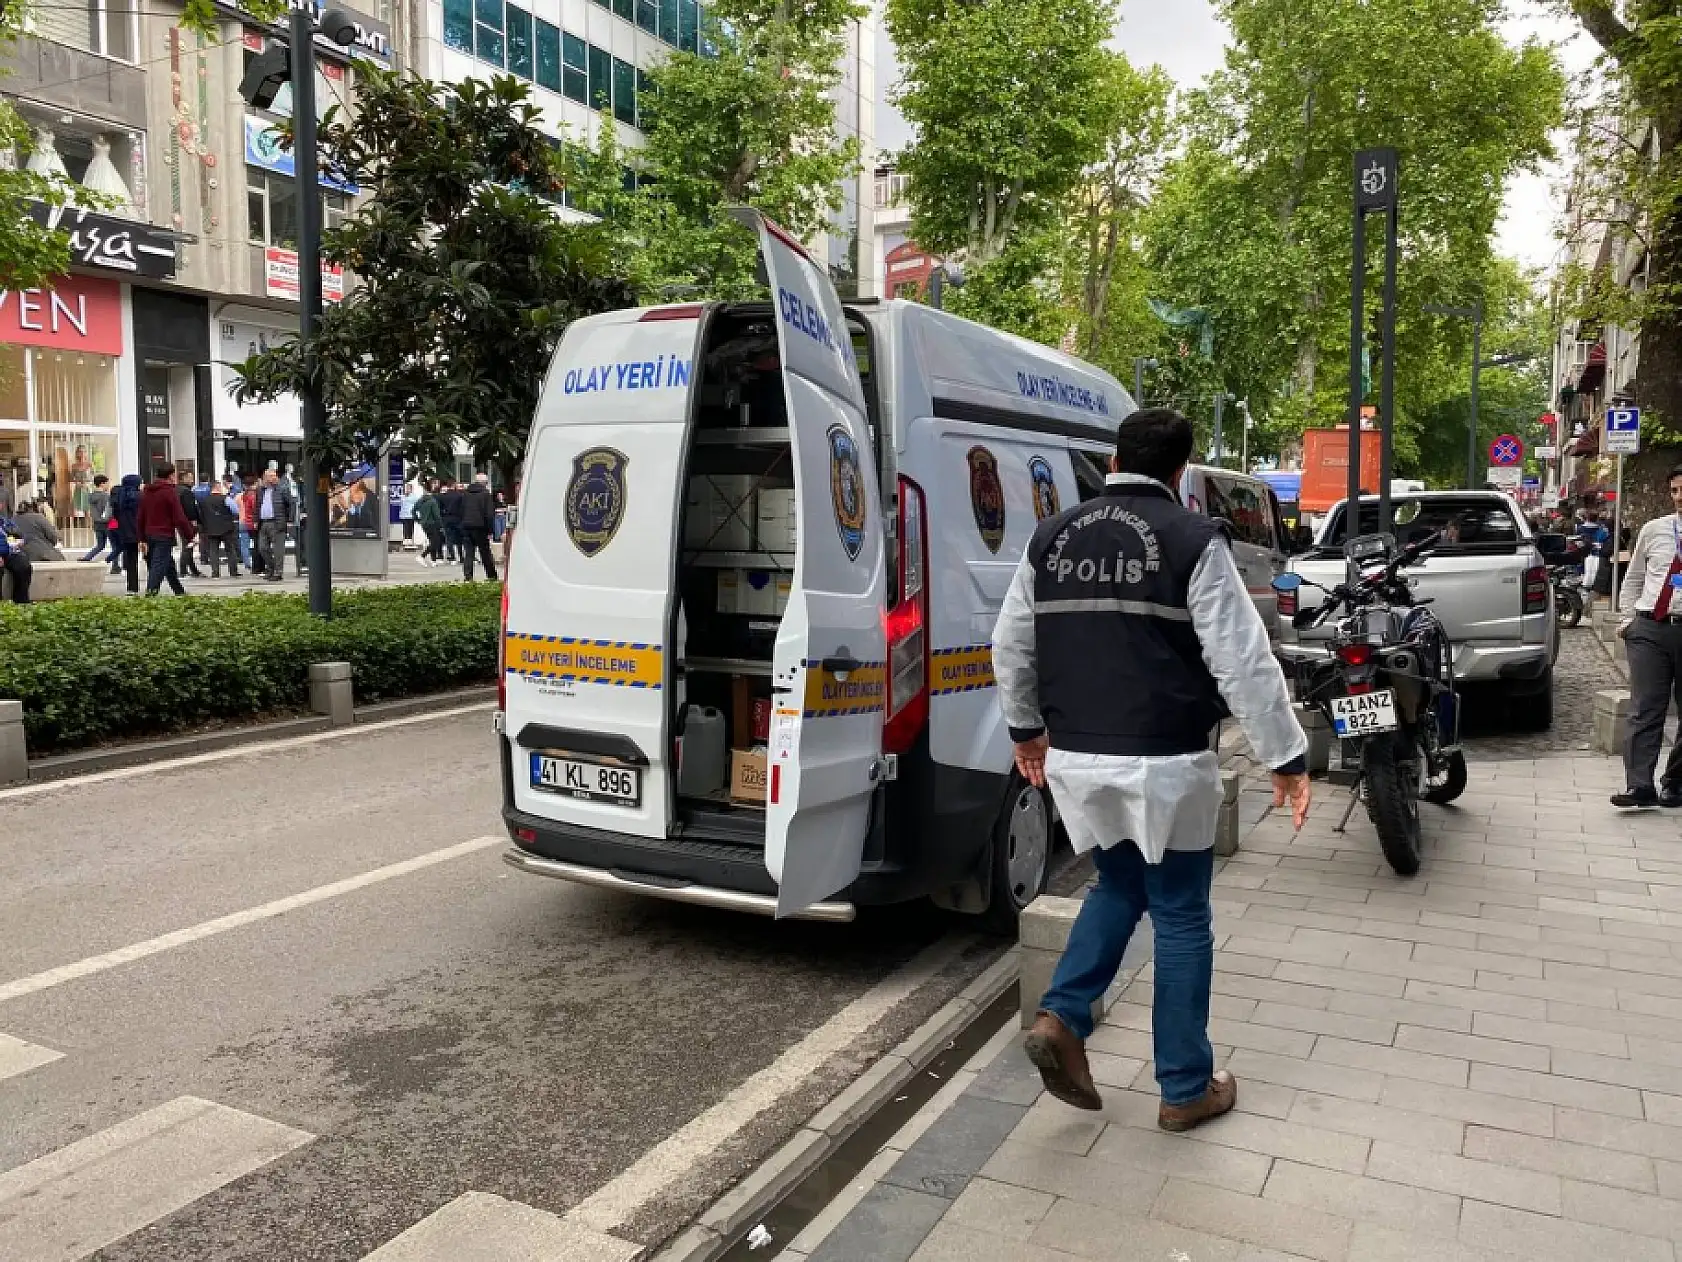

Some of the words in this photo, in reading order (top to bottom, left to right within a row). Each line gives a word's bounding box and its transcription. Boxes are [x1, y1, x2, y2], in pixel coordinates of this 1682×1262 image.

[564, 364, 613, 395] OLAY
[616, 354, 664, 390] YERİ
[1613, 411, 1633, 430] P
[1057, 550, 1144, 583] POLİS
[520, 649, 546, 665] OLAY
[548, 650, 573, 667] YERİ
[575, 650, 637, 674] İNCELEME
[1349, 711, 1379, 729] 822
[541, 759, 558, 783] 41
[564, 763, 590, 789] KL
[598, 768, 632, 796] 896
